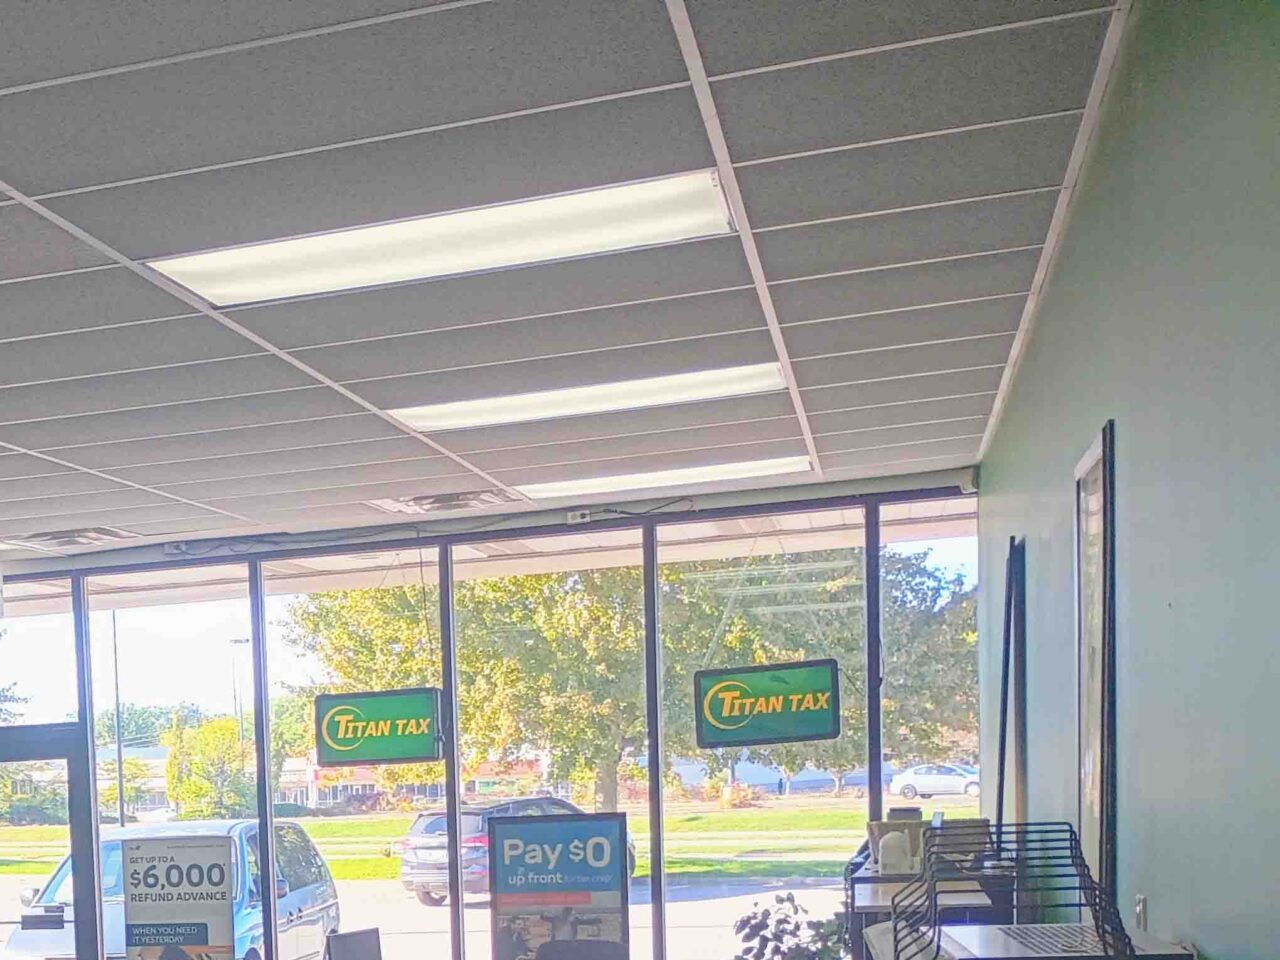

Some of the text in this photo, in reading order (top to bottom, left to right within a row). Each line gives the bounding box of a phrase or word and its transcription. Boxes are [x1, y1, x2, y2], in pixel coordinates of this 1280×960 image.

[718, 691, 830, 717] TITAN TAX
[335, 714, 431, 739] TITAN TAX
[129, 856, 144, 864] GET
[503, 836, 611, 870] Pay $0
[130, 863, 225, 890] $6,000
[508, 874, 525, 886] up
[528, 872, 563, 884] front
[130, 891, 227, 902] REFUND ADVANCE
[132, 927, 157, 935] WHEN
[176, 926, 197, 934] NEED
[132, 936, 184, 944] IT YESTERDAY
